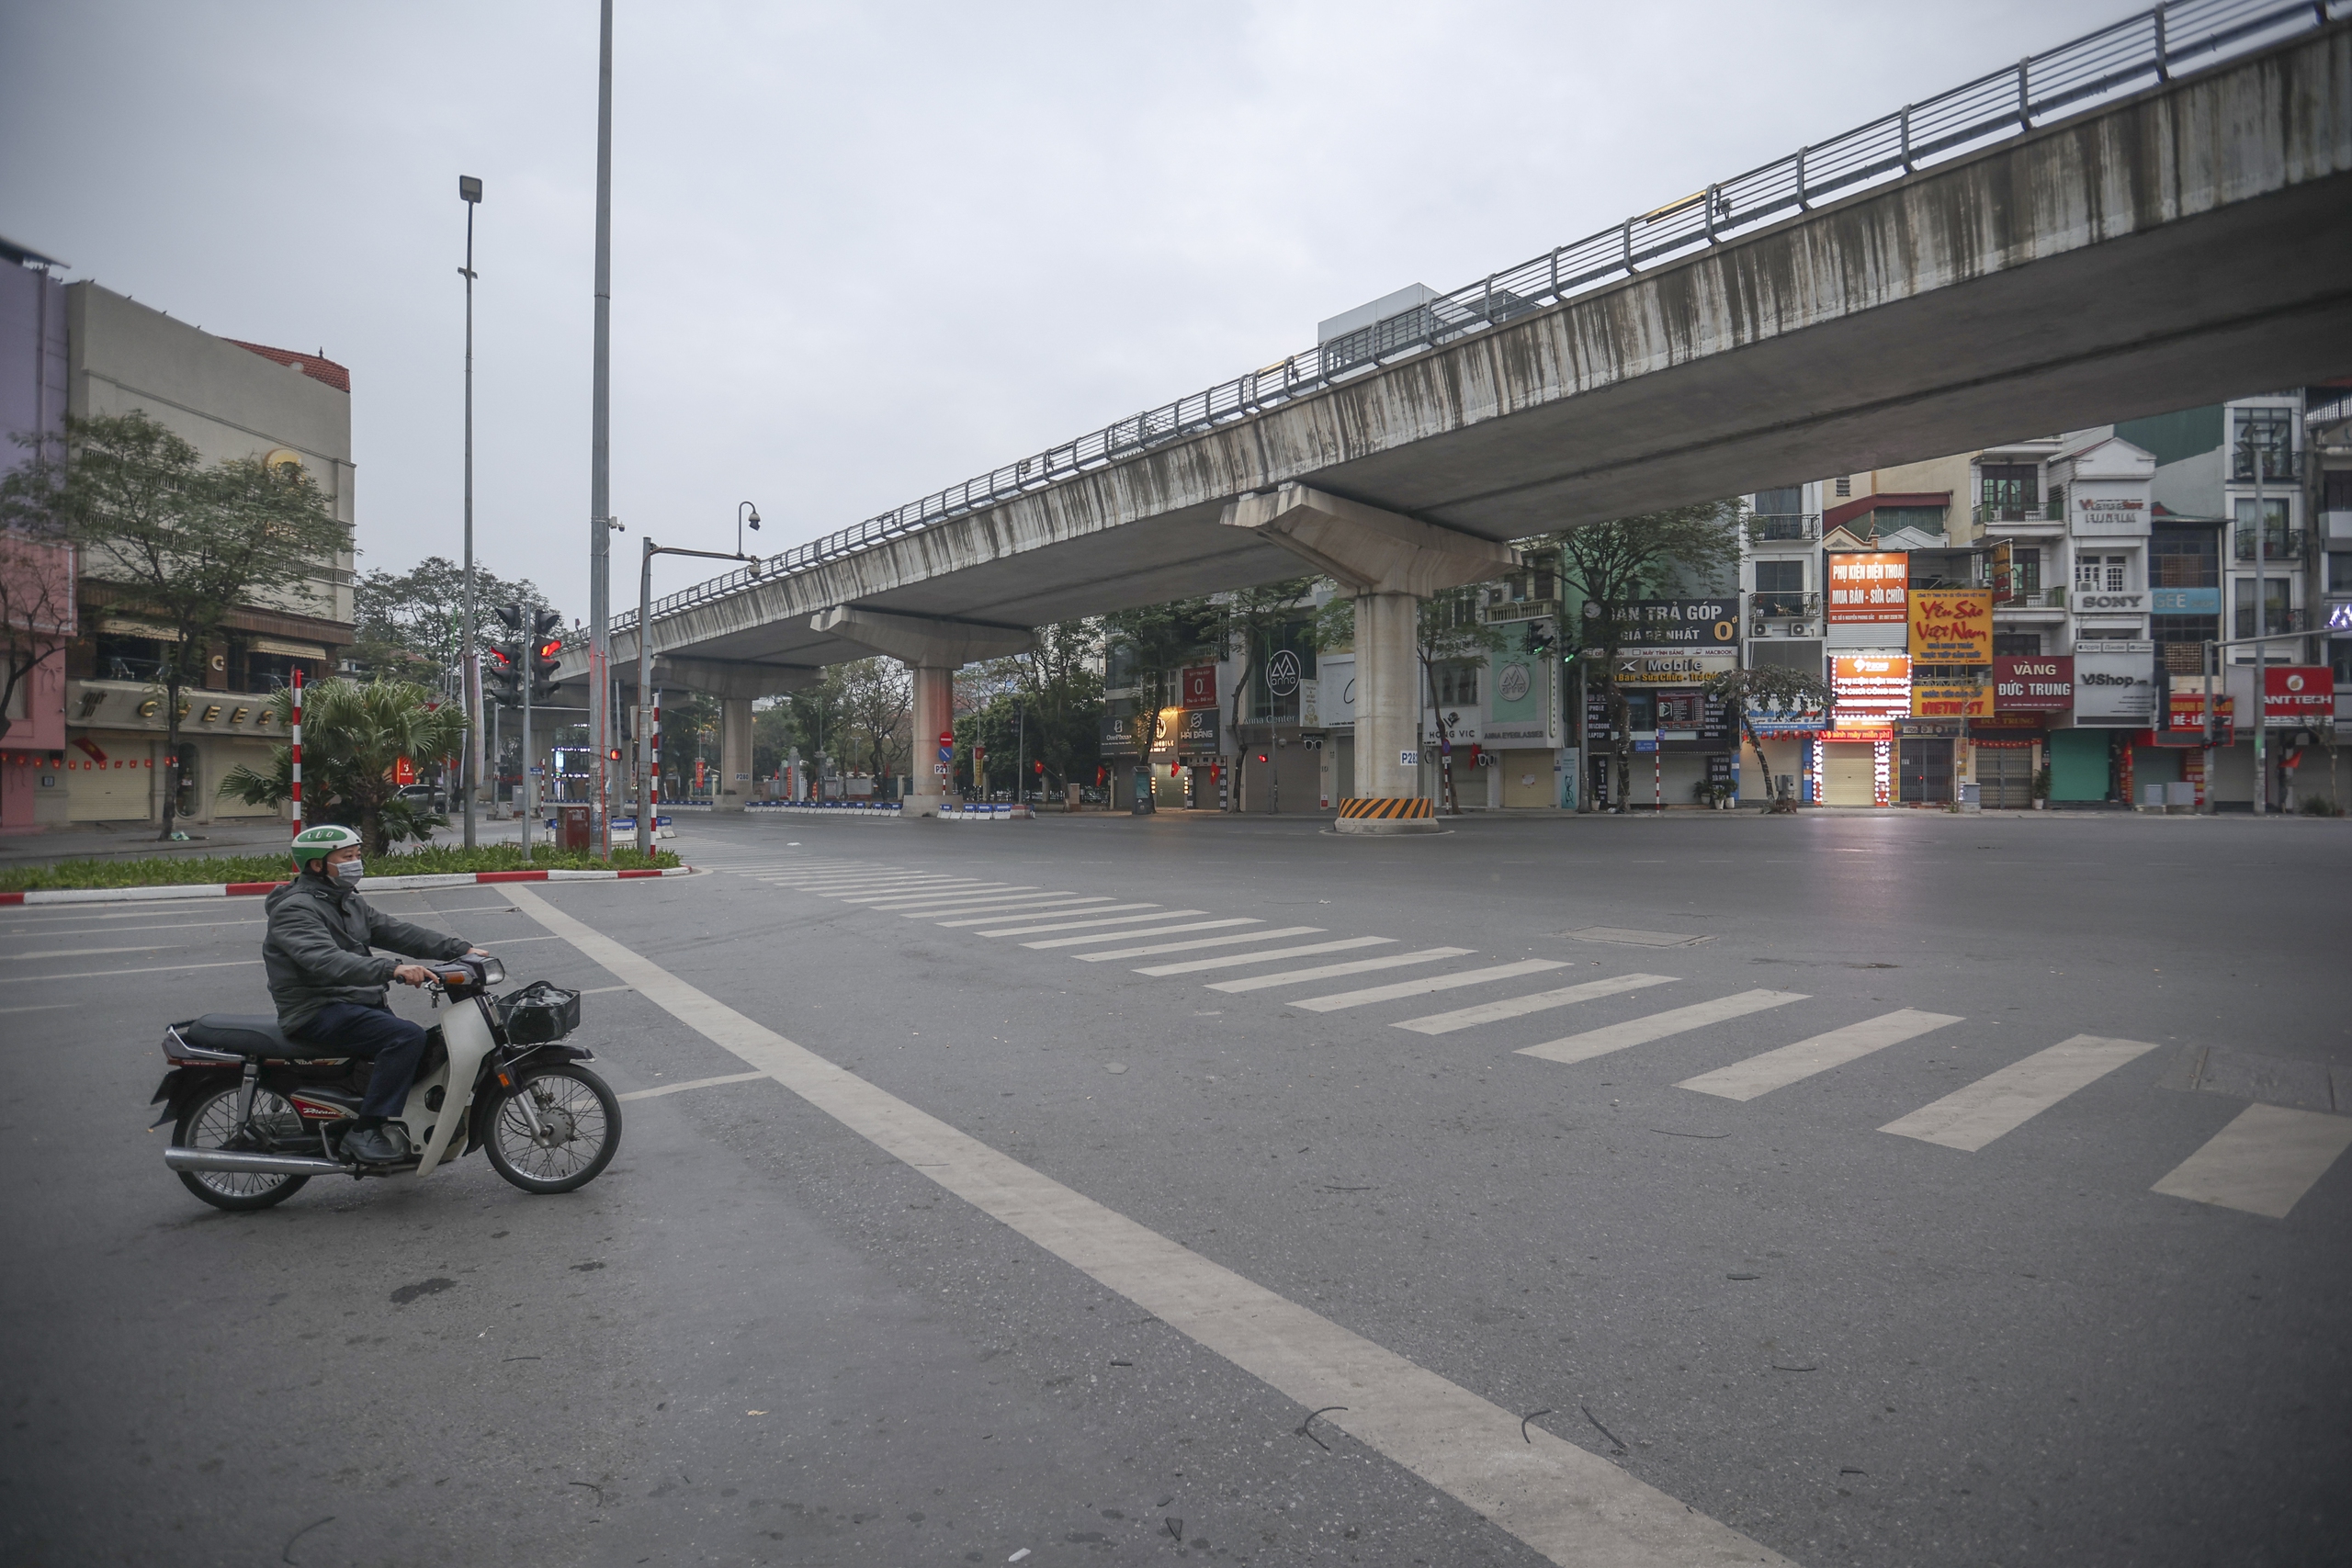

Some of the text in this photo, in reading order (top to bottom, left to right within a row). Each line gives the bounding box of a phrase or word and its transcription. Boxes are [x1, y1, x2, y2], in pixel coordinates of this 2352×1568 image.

[2085, 513, 2136, 524] FUJIFILM
[1833, 561, 1905, 582] PHỤ KIỆN ĐIỆN THOẠI
[1832, 590, 1848, 604] MUA
[1849, 587, 1864, 604] BÁN
[1870, 585, 1884, 604] SỬA
[1885, 586, 1905, 604] CHỮA
[2083, 595, 2143, 607] SONY
[1645, 602, 1681, 621] TRẢ
[1686, 602, 1723, 621] GÓP
[1666, 626, 1700, 640] NHẤT
[1950, 620, 1987, 642] Nam
[1646, 659, 1703, 671] Mobile
[2012, 661, 2057, 675] VÀNG
[1271, 677, 1296, 686] anna
[1997, 680, 2071, 696] ĐỨC TRUNG
[2293, 695, 2332, 705] TECH
[1266, 715, 1295, 724] Center
[1879, 730, 1890, 739] phí
[302, 1107, 336, 1115] Dream
